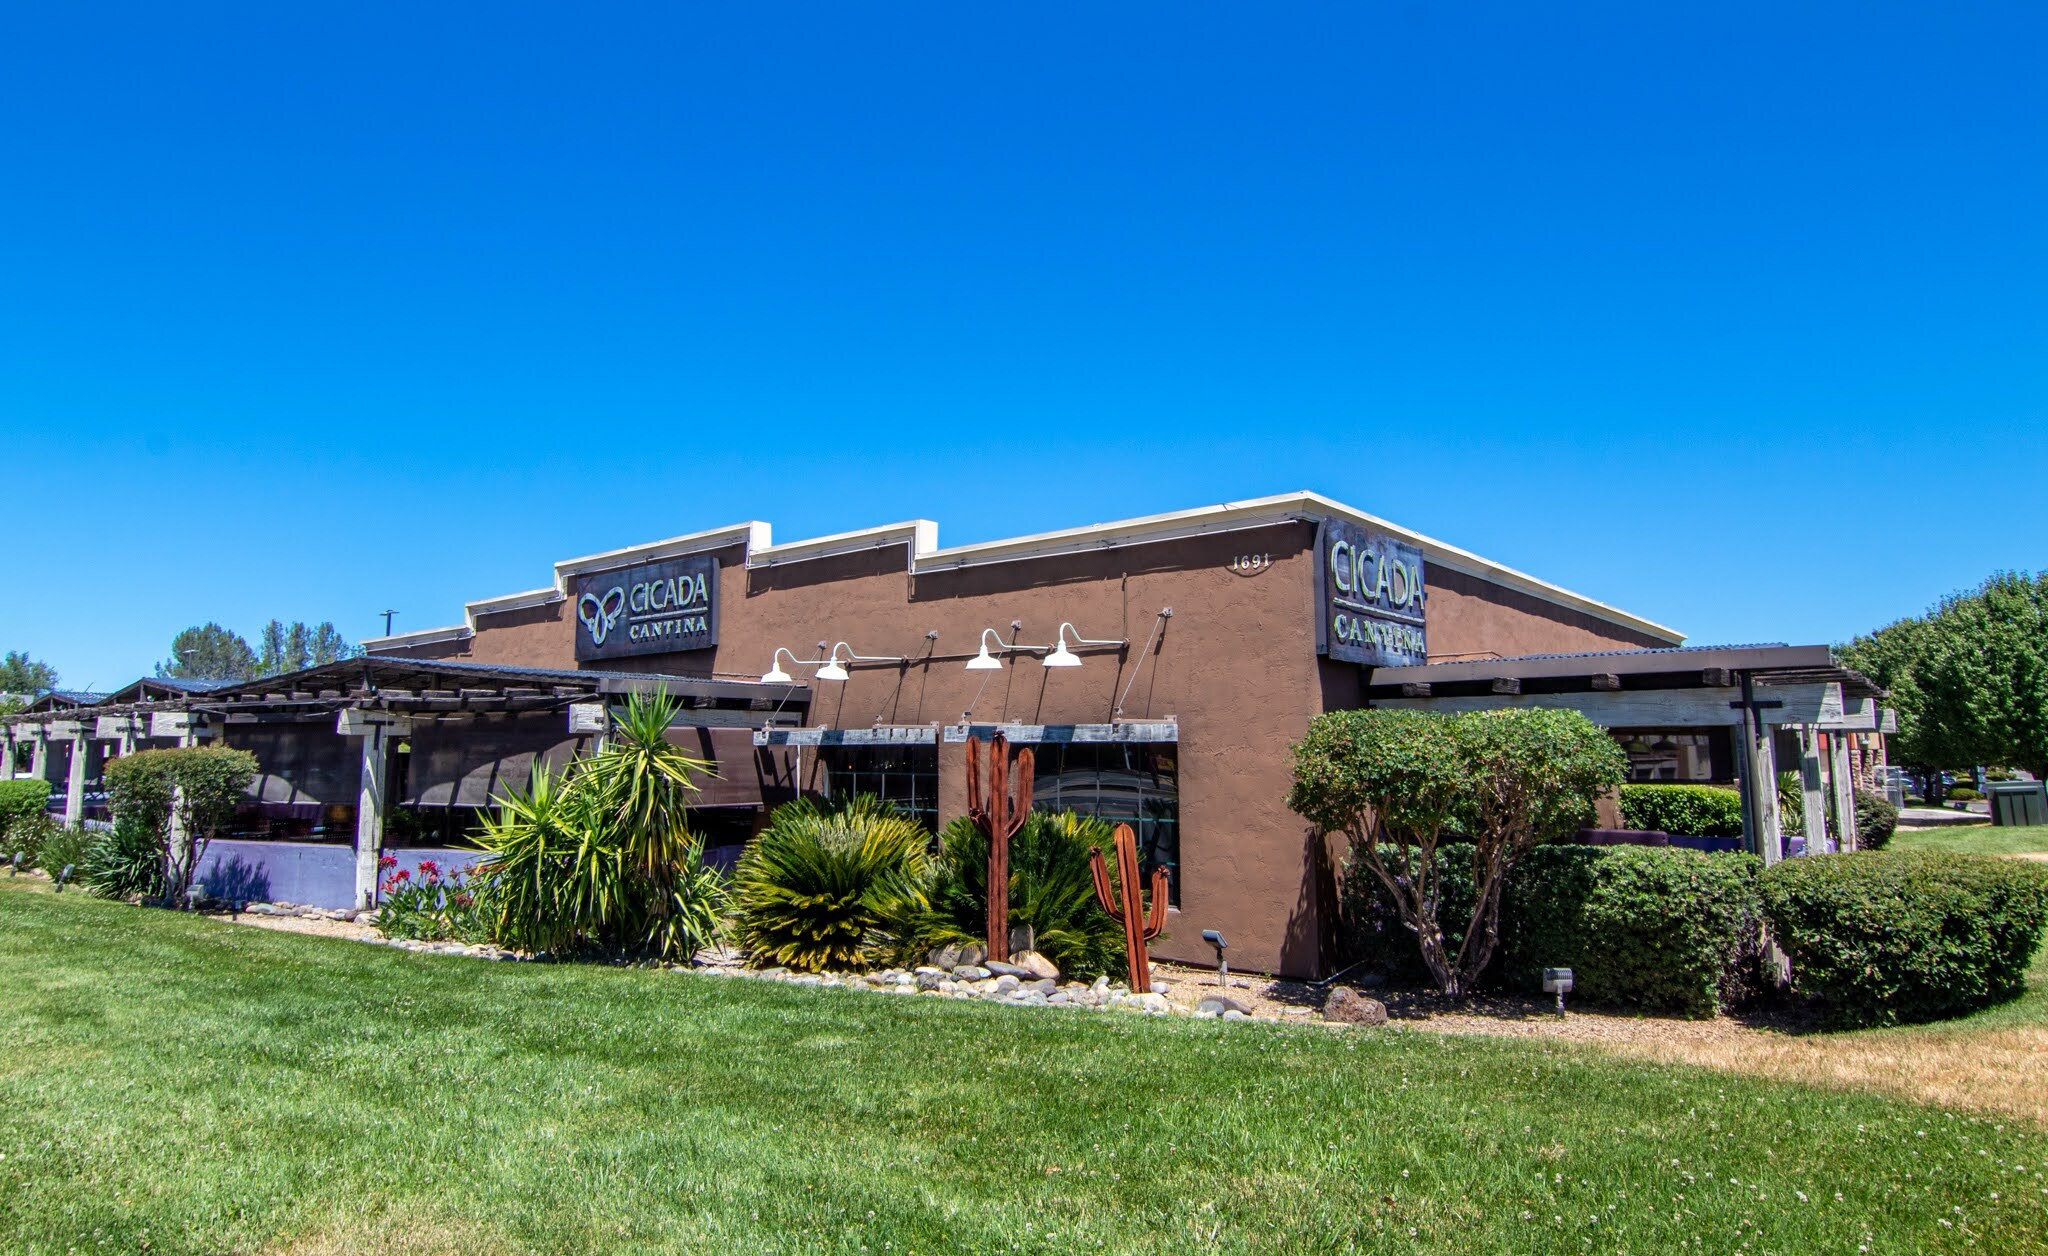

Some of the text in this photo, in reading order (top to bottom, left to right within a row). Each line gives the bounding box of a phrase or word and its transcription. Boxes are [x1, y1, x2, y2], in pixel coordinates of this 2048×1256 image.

[1233, 553, 1270, 570] 1691
[1331, 540, 1425, 610] CICADA
[630, 573, 708, 612] CICADA
[629, 616, 708, 640] CANTINA
[1333, 614, 1426, 653] CANTINA
